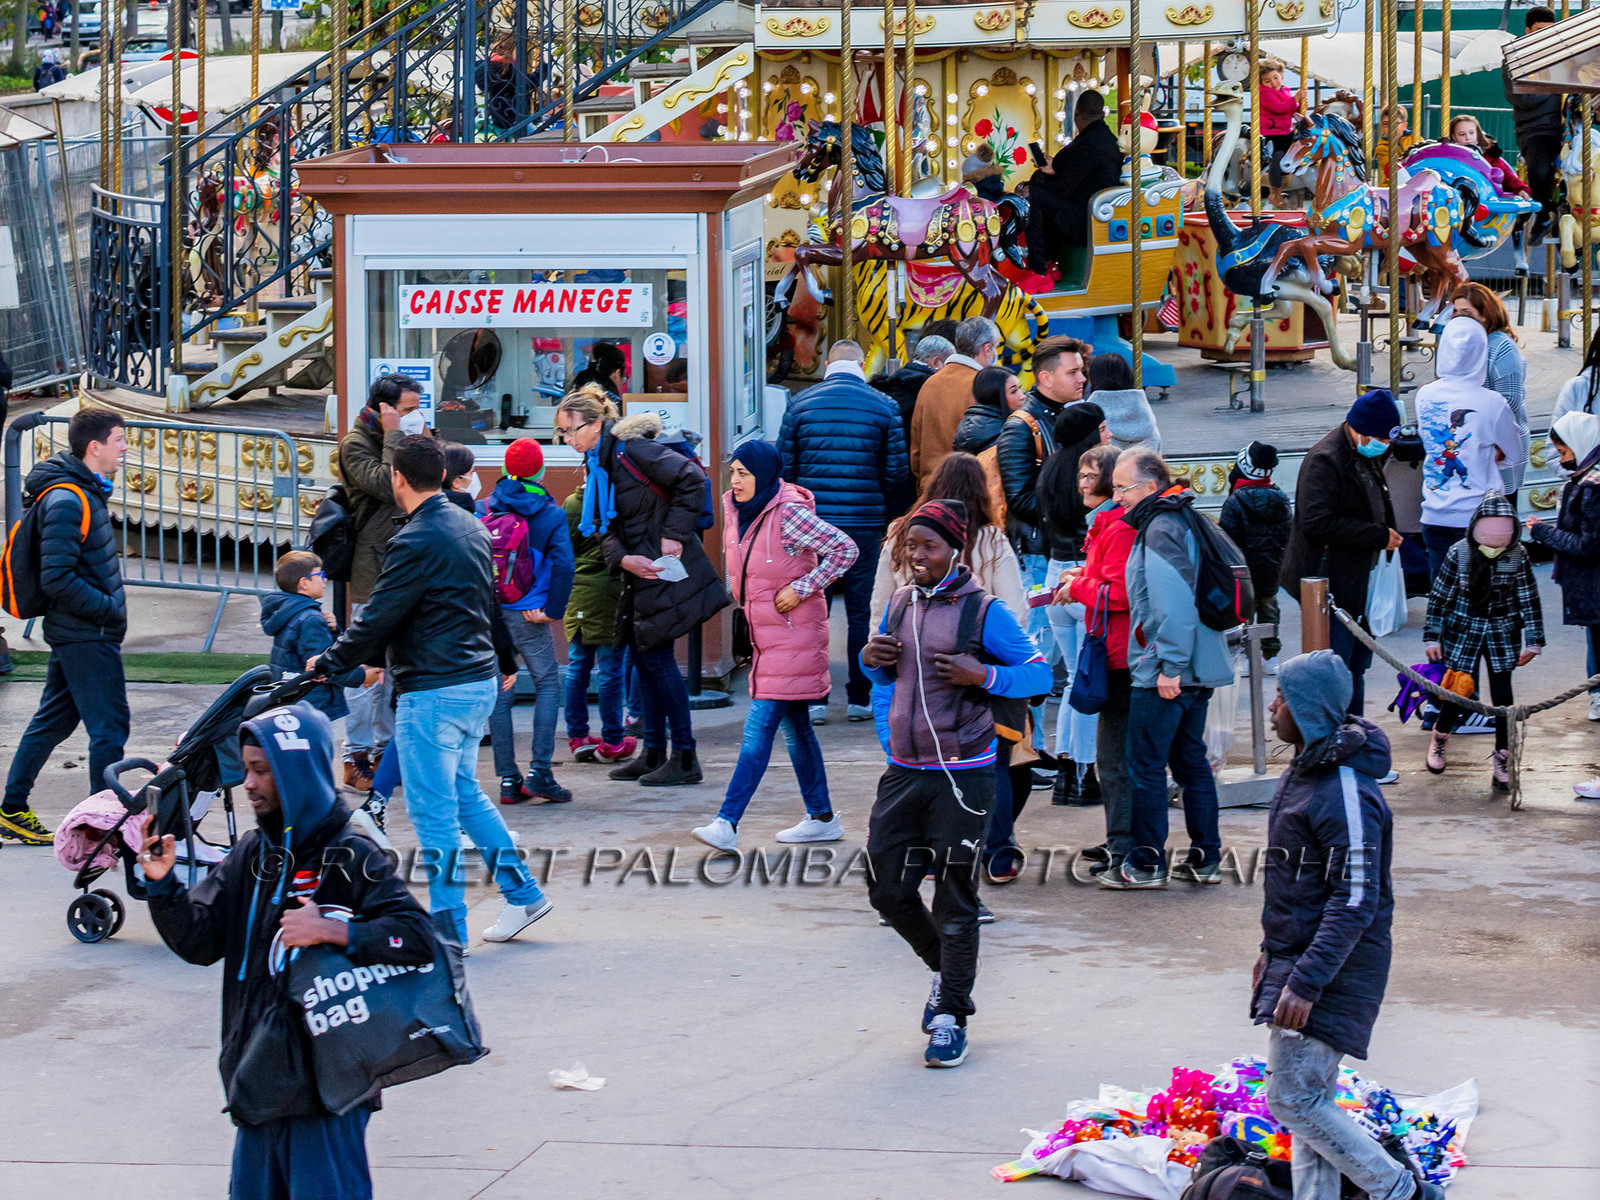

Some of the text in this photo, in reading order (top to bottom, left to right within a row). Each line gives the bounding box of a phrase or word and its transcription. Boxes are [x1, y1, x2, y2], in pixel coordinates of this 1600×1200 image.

[765, 264, 786, 276] cial
[410, 288, 632, 314] CAISSE MANEGE
[304, 994, 371, 1037] bag
